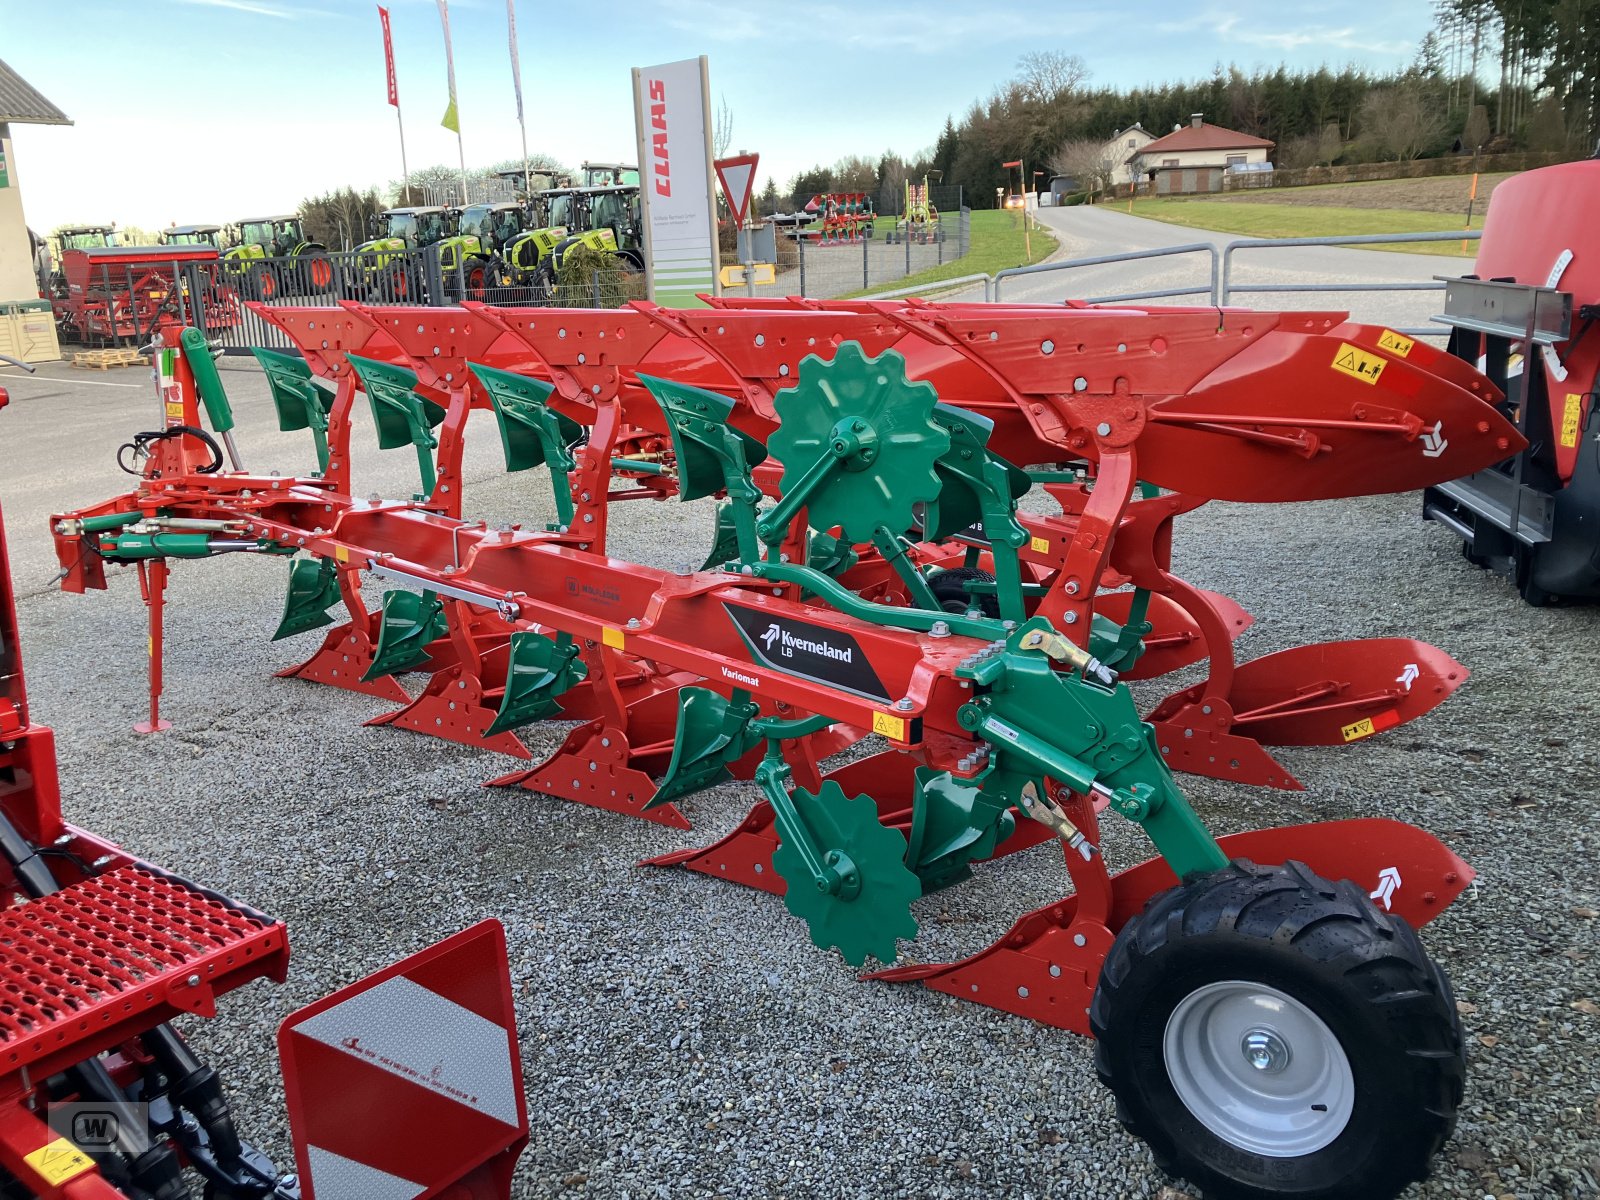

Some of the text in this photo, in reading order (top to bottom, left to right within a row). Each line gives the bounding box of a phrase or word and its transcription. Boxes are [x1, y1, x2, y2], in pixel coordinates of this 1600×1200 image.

[649, 79, 671, 198] CLAAS
[781, 630, 852, 664] Kverneland
[781, 646, 793, 658] LB
[721, 666, 760, 687] Variomat
